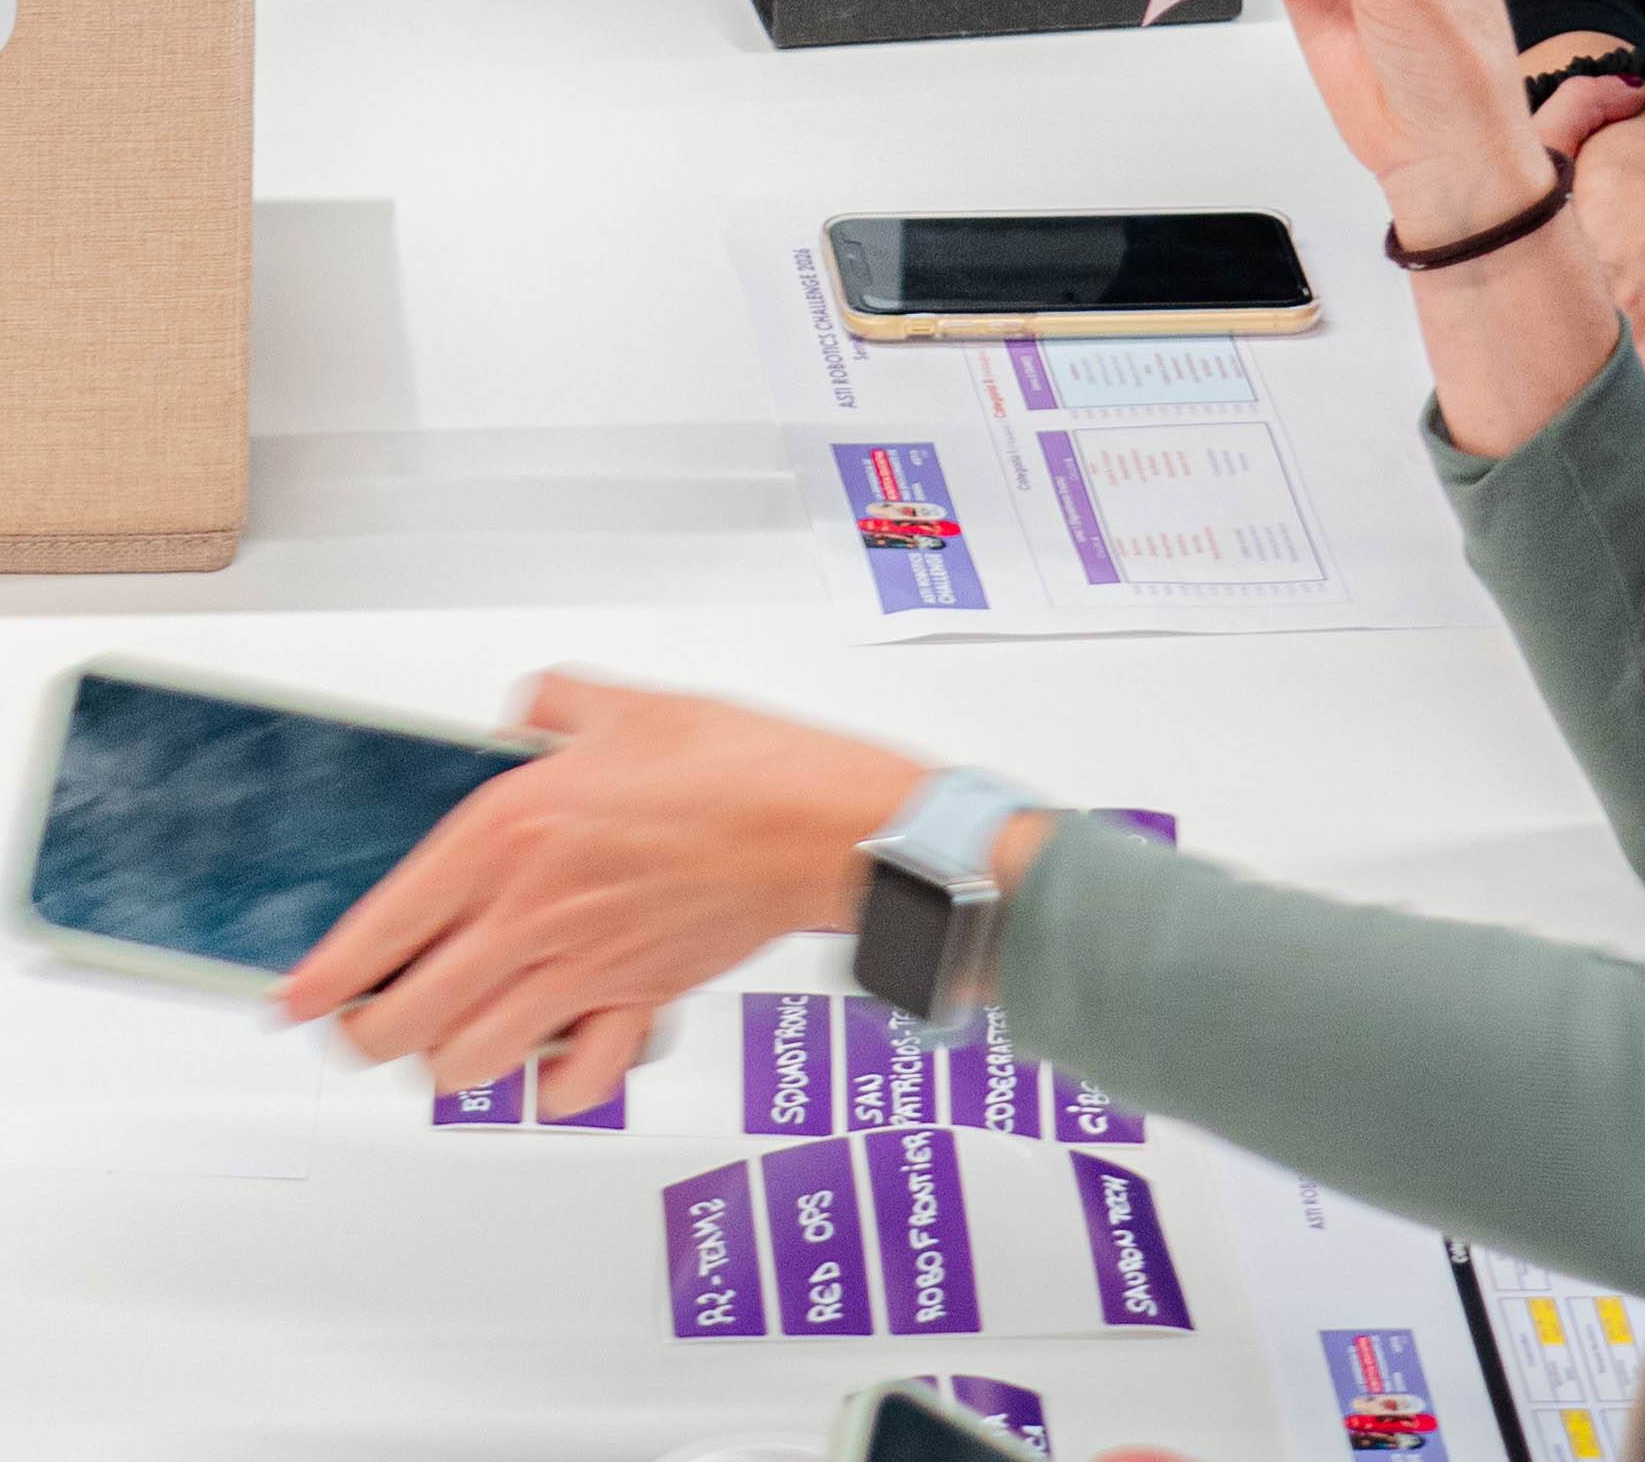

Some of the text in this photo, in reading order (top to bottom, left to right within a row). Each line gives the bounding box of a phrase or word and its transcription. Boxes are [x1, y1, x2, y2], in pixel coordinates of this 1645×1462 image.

[792, 247, 857, 409] ASTI ROBOTICS CHALLENGE 2026
[771, 994, 811, 1125] SQUADTRONIC
[854, 1074, 884, 1124] SAN
[690, 1197, 738, 1327] R2-TEAM2
[797, 1190, 845, 1324] RED OPS
[1099, 1173, 1159, 1318] SAURON TECH
